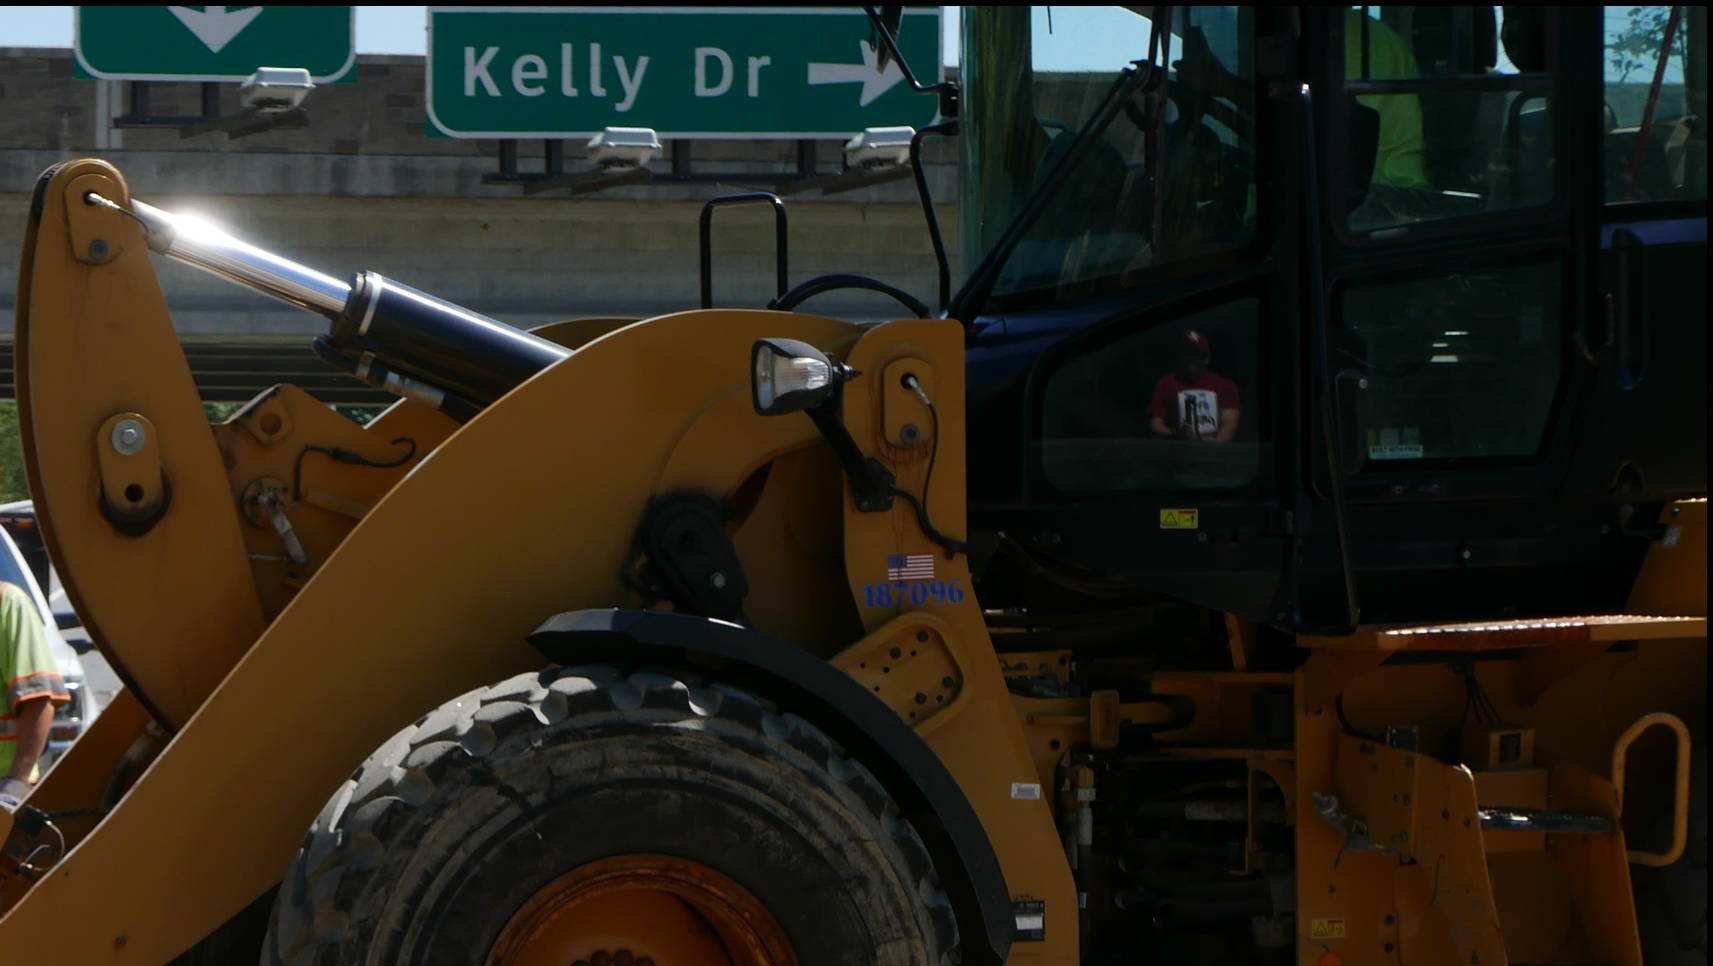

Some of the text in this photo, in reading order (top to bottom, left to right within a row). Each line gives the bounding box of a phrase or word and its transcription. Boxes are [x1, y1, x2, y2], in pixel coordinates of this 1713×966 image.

[463, 43, 772, 112] Kelly Dr
[860, 578, 965, 608] 187096
